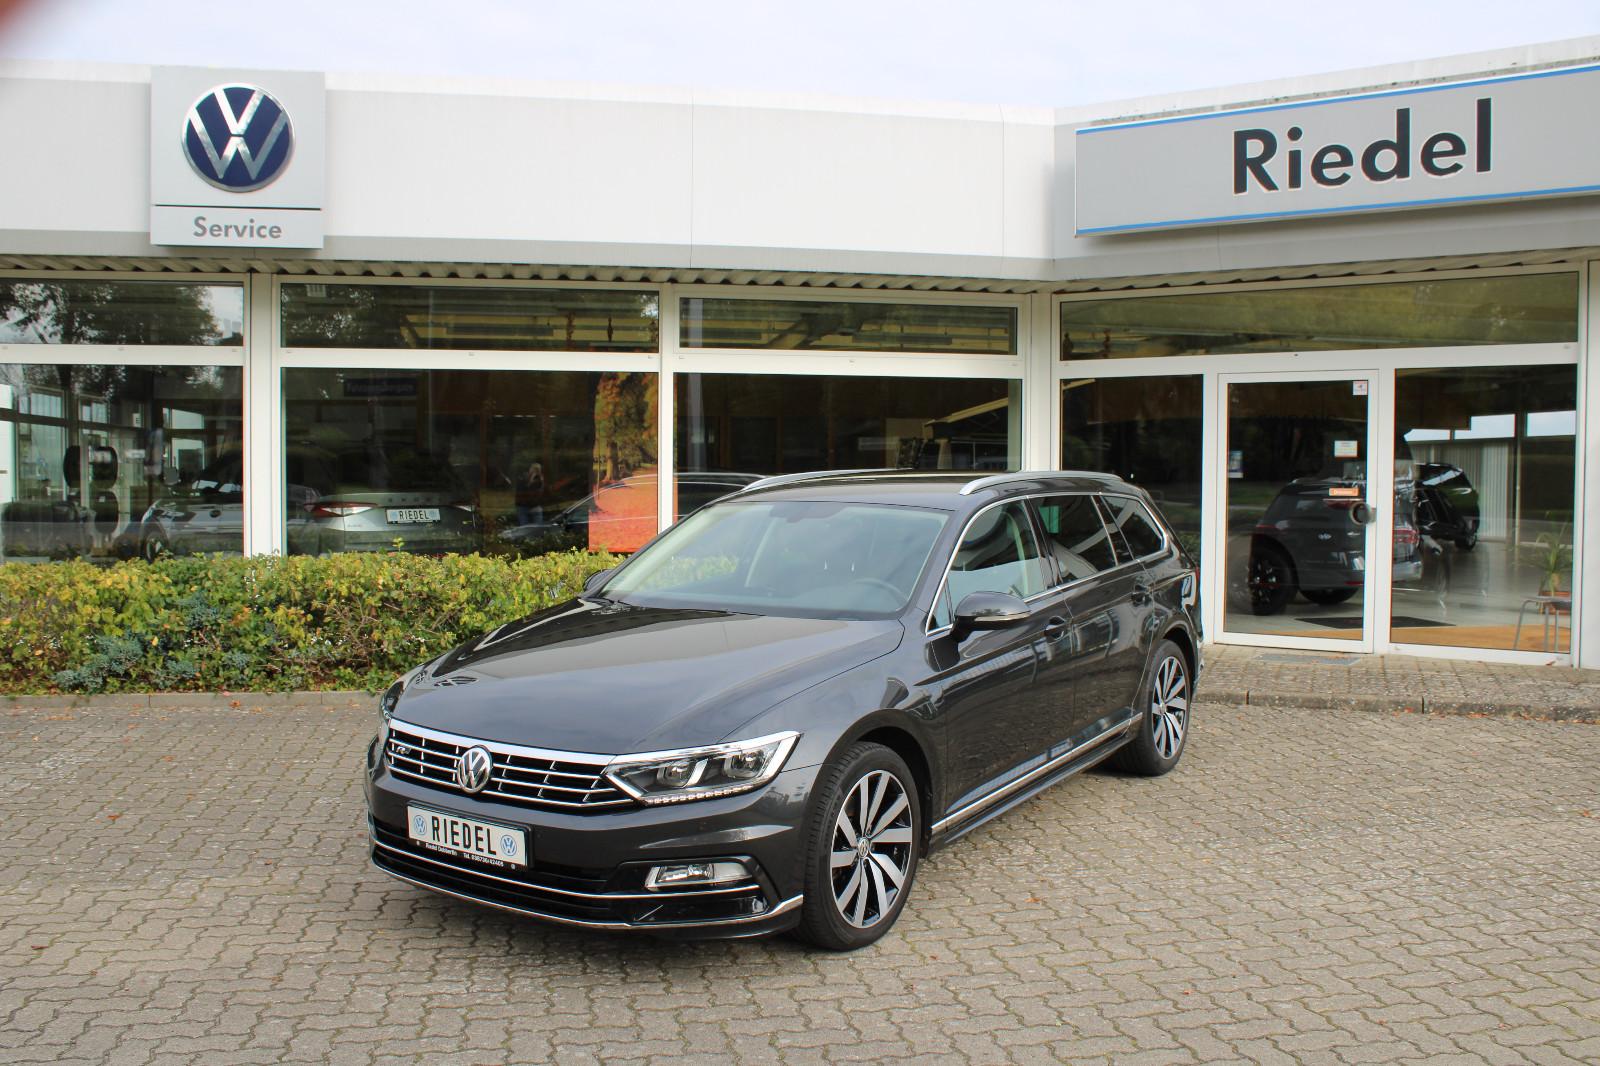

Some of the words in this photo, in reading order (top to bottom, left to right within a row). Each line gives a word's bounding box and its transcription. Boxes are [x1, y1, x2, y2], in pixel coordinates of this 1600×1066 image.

[1234, 98, 1491, 194] Riedel
[193, 216, 282, 239] Service
[399, 510, 430, 520] RIEDEL
[431, 815, 497, 856] RIEDEL
